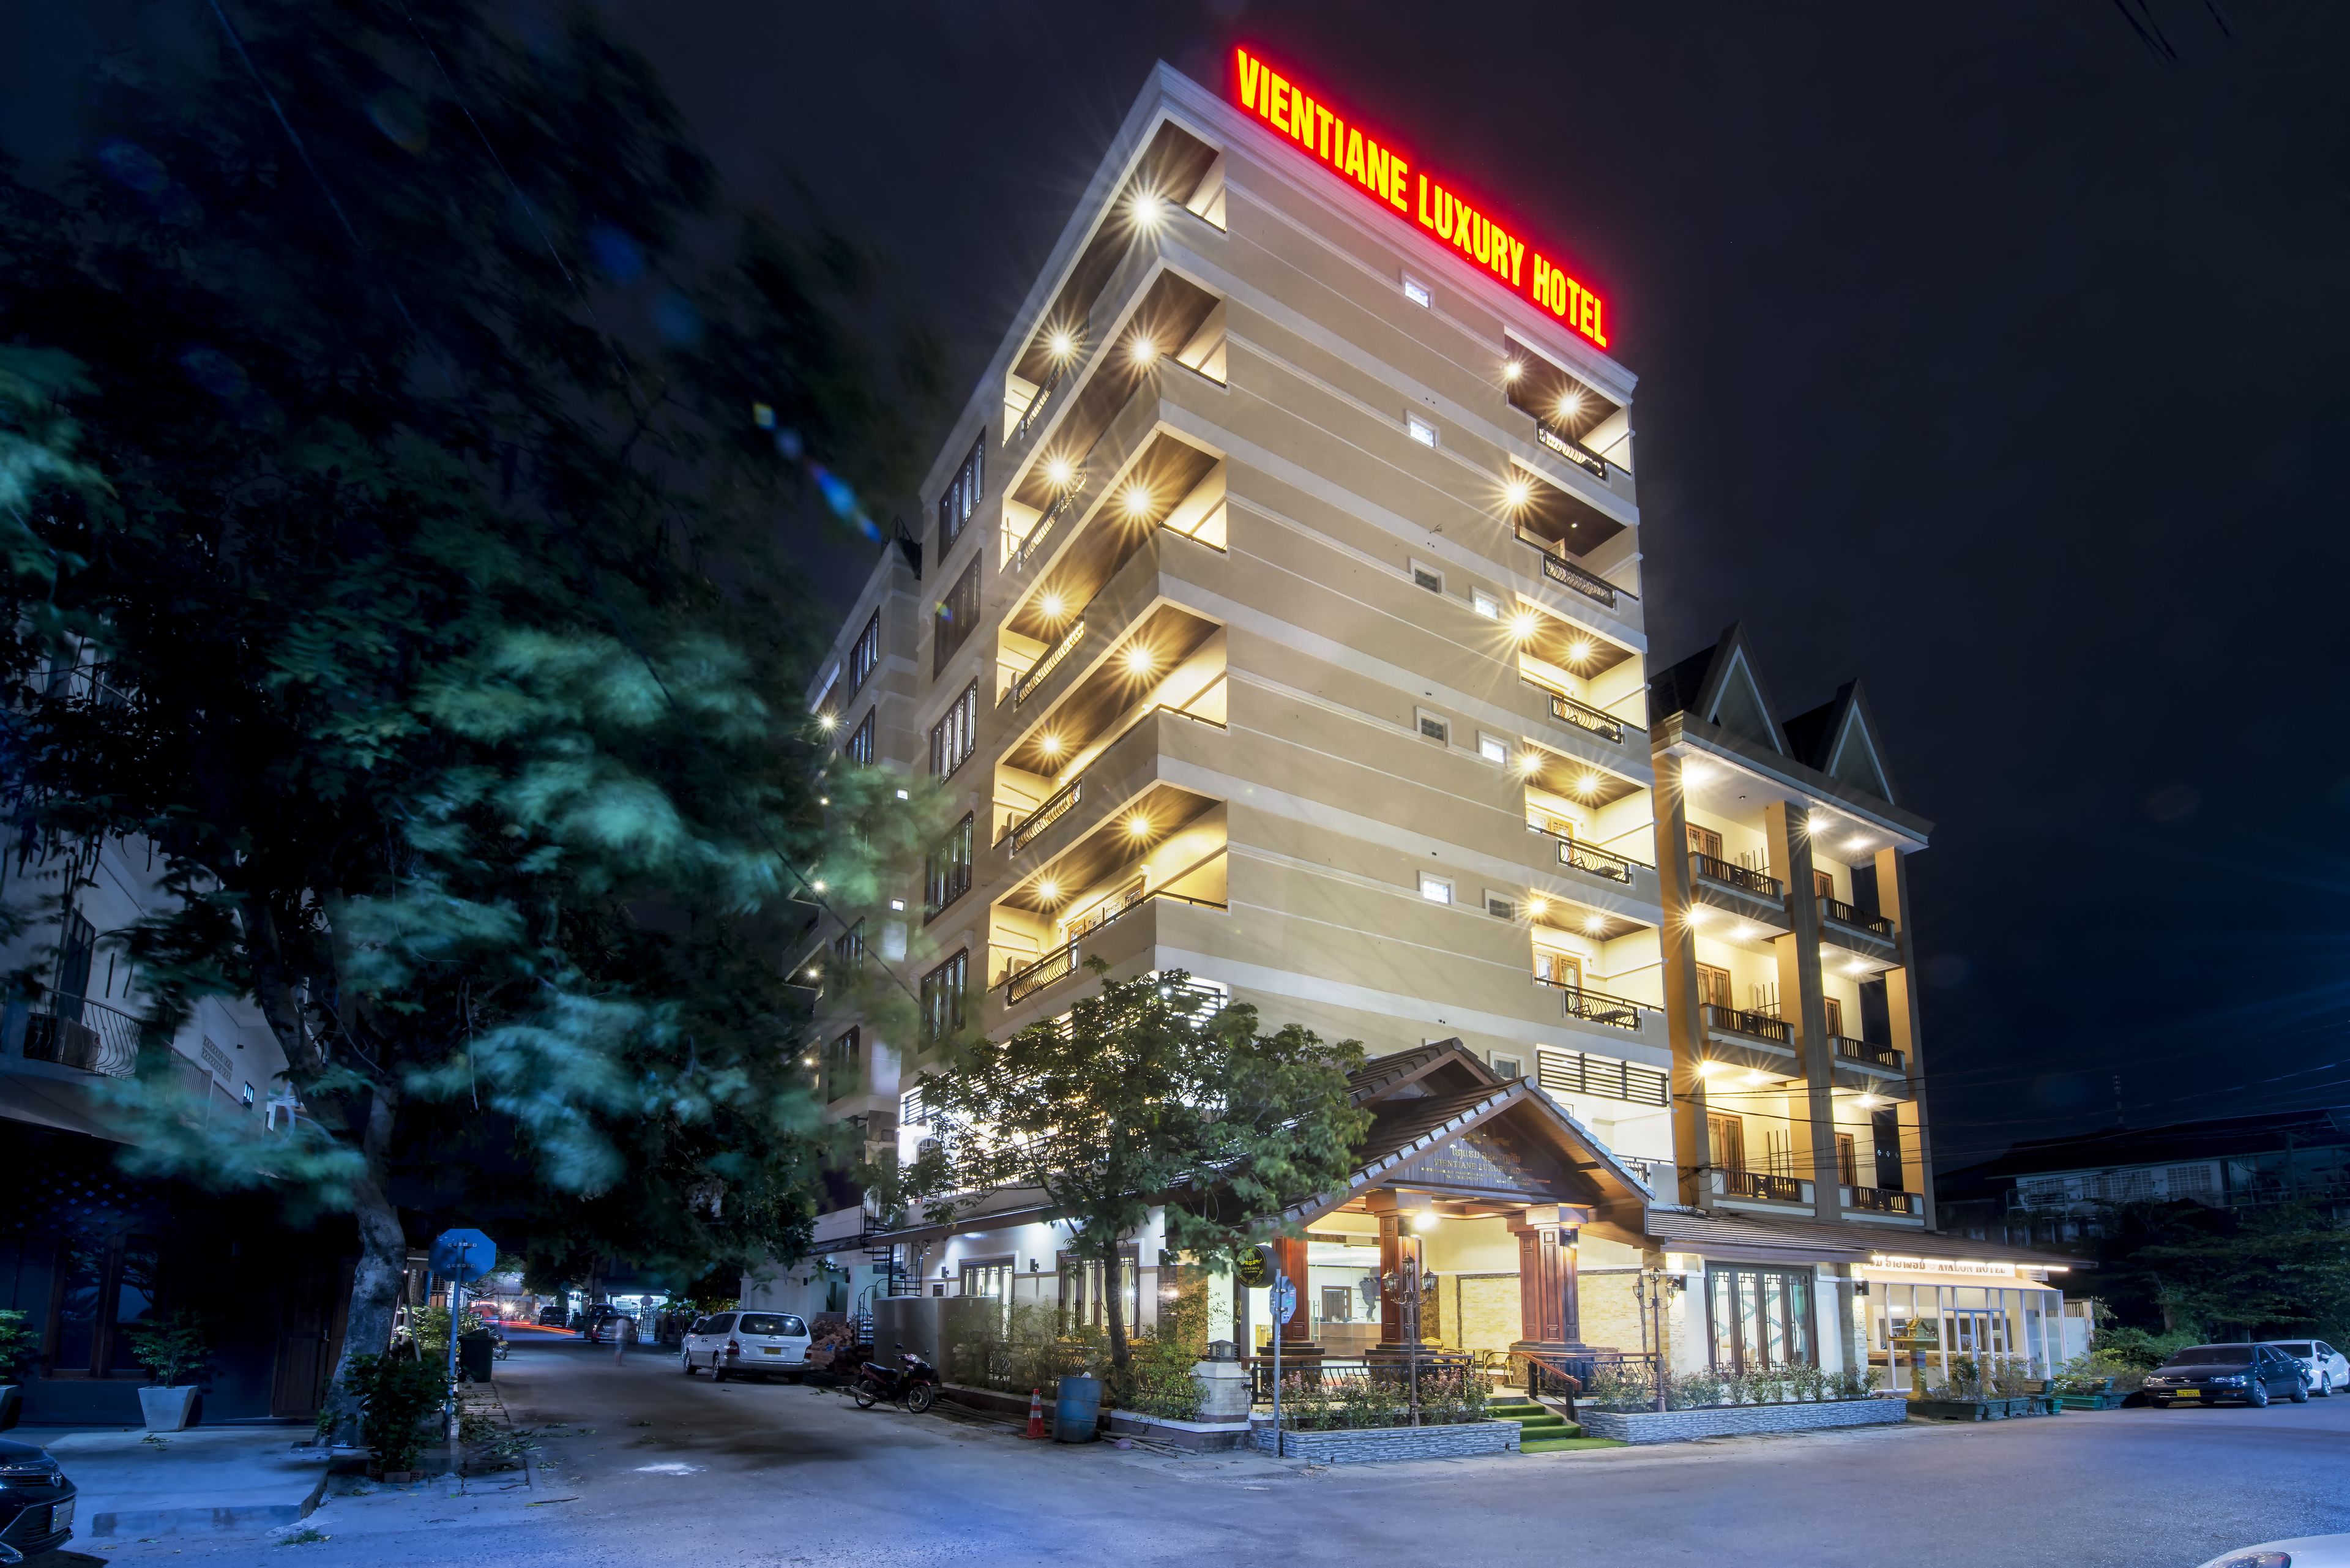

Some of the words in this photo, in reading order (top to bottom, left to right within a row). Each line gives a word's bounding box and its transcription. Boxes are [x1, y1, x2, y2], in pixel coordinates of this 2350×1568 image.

[1237, 48, 1408, 212] VIENTIANE
[1419, 174, 1524, 286] LUXURY
[1533, 253, 1606, 348] HOTEL
[1434, 1159, 1476, 1170] VIENTIANE
[1479, 1164, 1508, 1173] LUXURY
[1938, 1263, 1972, 1273] AVALON
